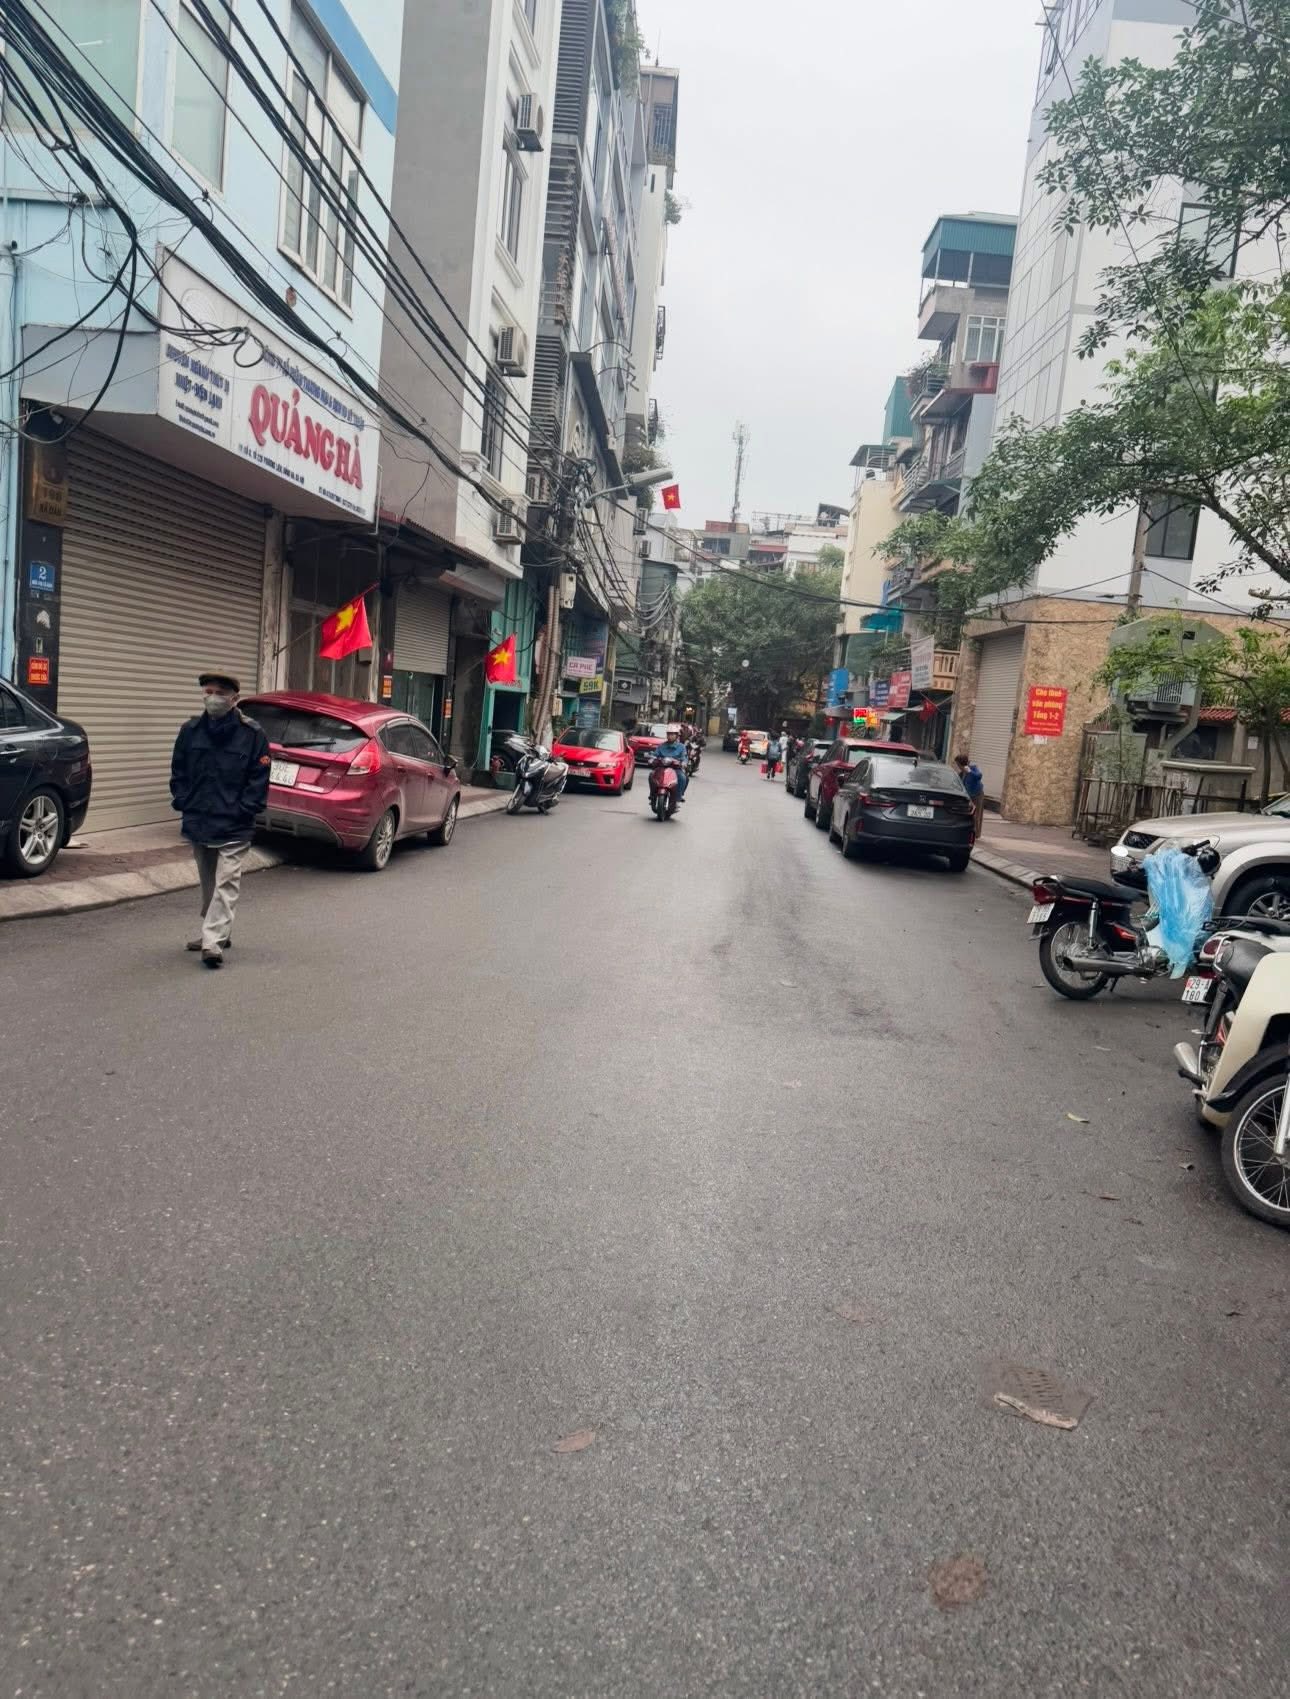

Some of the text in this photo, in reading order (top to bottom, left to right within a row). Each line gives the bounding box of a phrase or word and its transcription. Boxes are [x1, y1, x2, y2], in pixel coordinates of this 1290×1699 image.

[248, 384, 335, 471] QUẢNG
[334, 434, 363, 490] HÀ
[39, 566, 47, 580] 2
[1035, 688, 1047, 697] Cho
